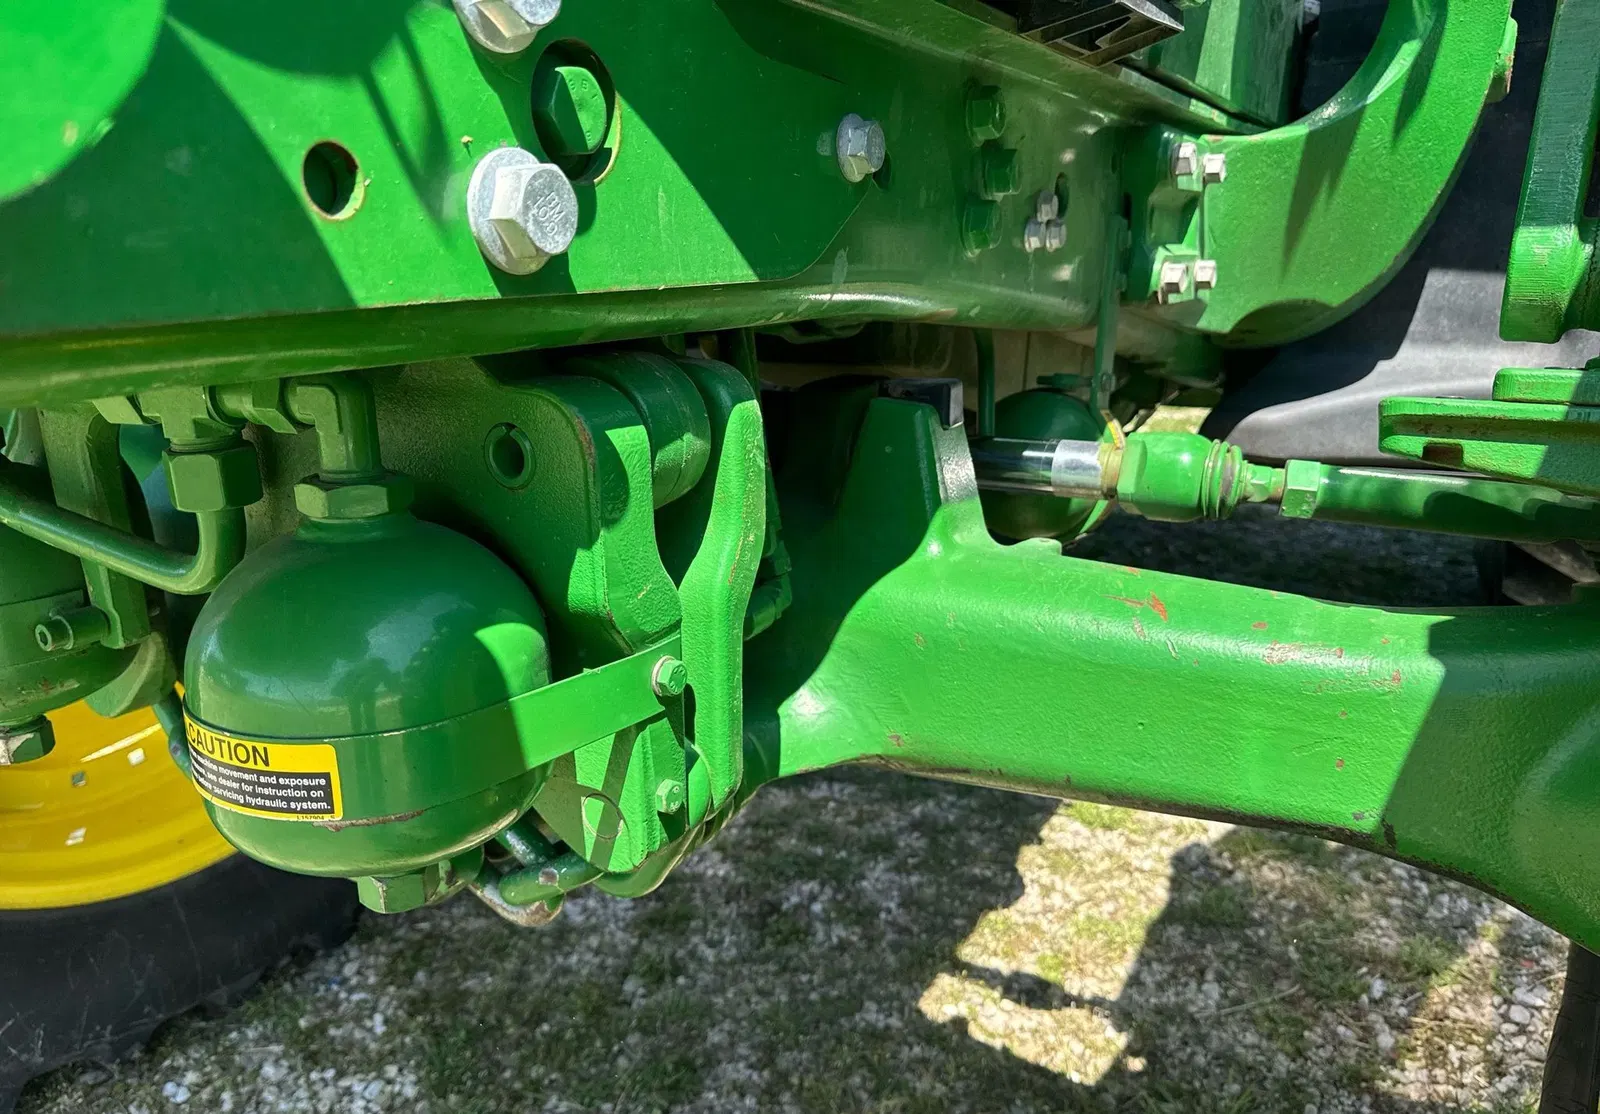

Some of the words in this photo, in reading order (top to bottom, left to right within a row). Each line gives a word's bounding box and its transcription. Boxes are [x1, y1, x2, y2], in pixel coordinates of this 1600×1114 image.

[189, 722, 269, 767] CAUTION
[219, 766, 258, 781] movement
[260, 775, 276, 784] and
[279, 778, 326, 787] exposure
[219, 777, 240, 789] dealer
[241, 782, 253, 792] for
[255, 785, 307, 797] instruction
[310, 790, 324, 798] on
[245, 795, 287, 808] hydraulic
[290, 801, 331, 811] system.
